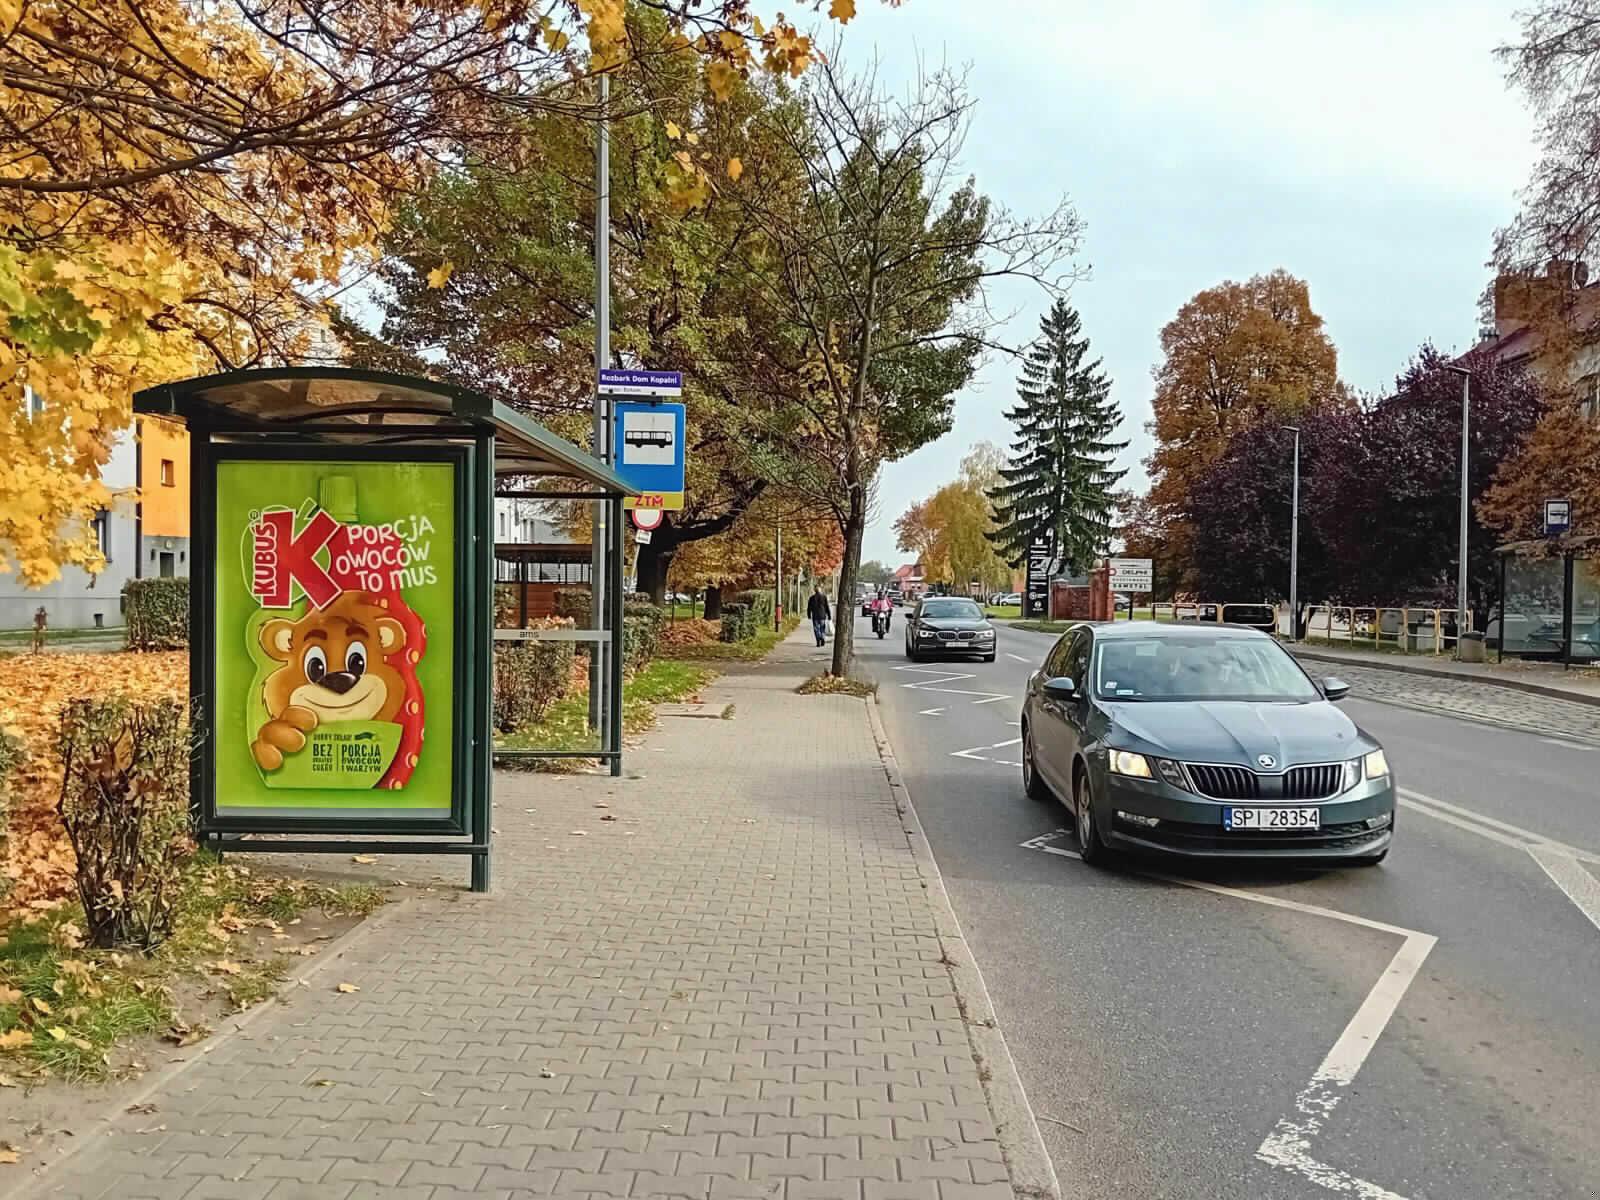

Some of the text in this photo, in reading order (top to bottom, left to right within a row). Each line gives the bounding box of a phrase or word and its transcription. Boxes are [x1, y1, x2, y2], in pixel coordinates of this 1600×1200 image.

[632, 375, 648, 383] Dom
[634, 495, 663, 507] ZTM
[347, 515, 435, 545] PORCJA
[253, 523, 277, 595] KUBUS
[261, 508, 342, 611] K
[336, 541, 430, 575] OWOCÓW
[356, 566, 437, 592] TO MUS
[313, 744, 333, 757] BEZ
[342, 744, 381, 758] PORCJA
[1269, 810, 1319, 826] 28354
